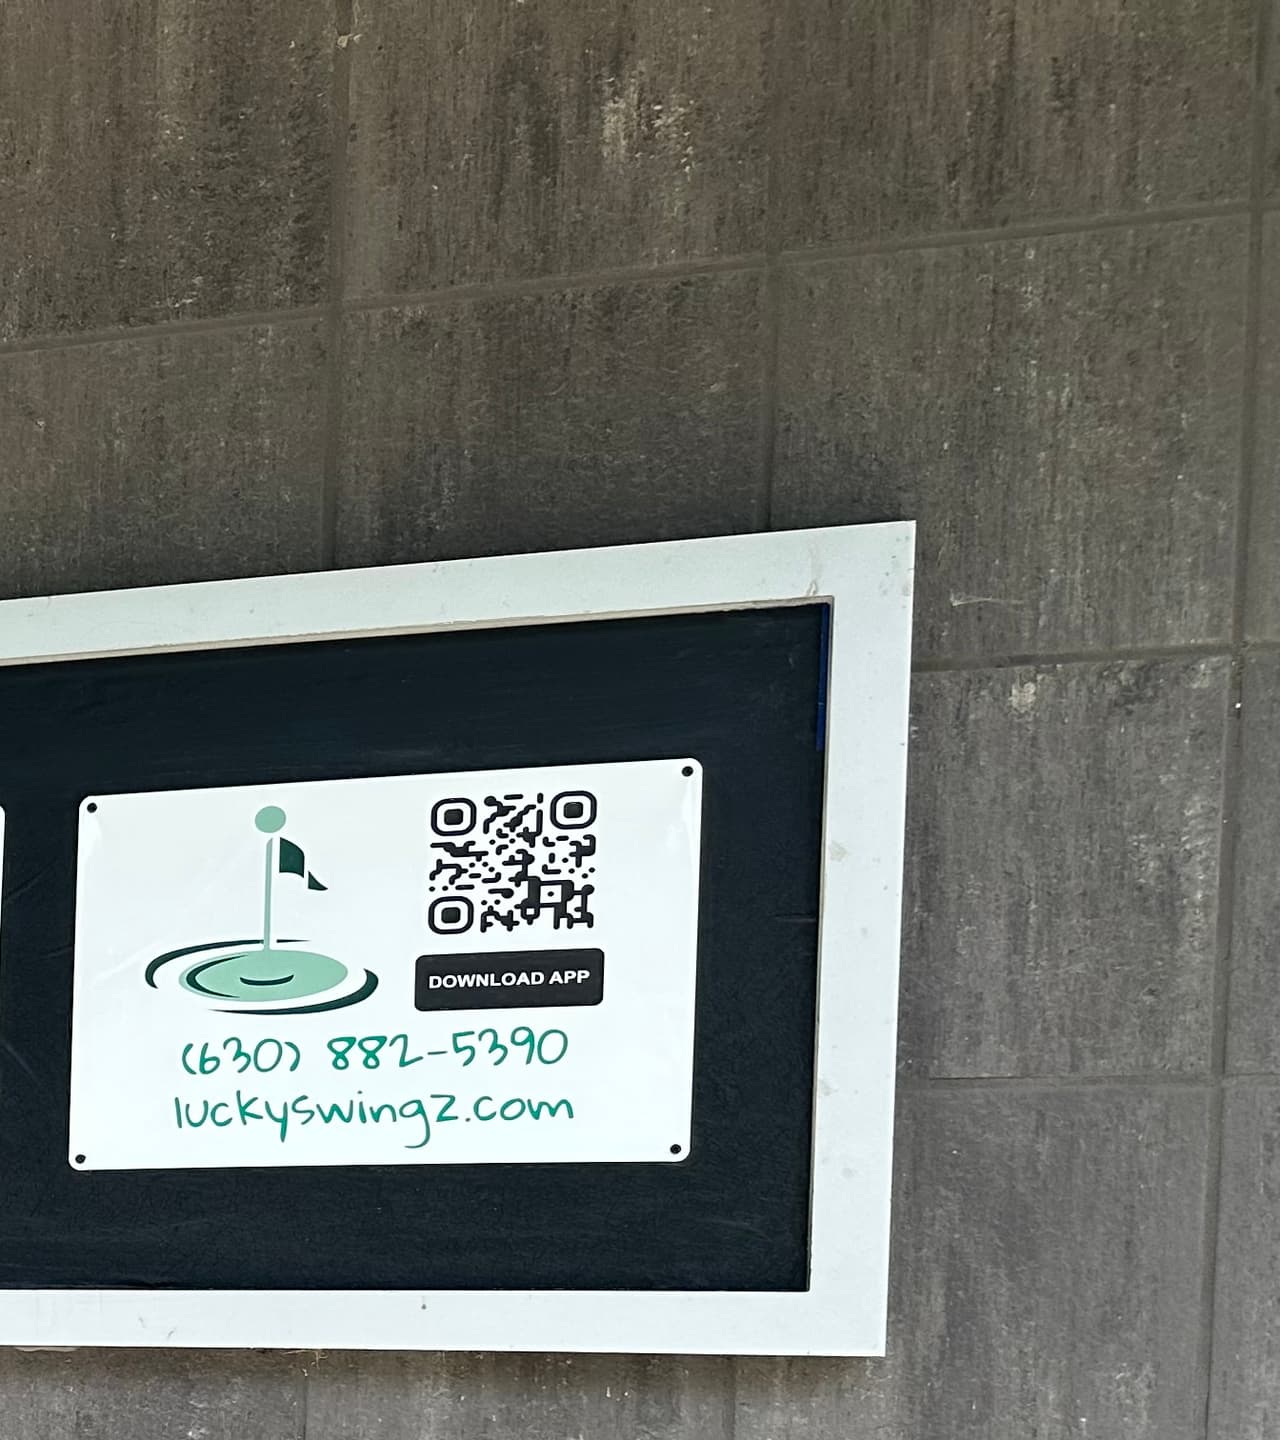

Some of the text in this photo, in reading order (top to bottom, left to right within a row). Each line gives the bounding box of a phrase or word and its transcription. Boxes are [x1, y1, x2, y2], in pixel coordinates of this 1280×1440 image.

[428, 969, 591, 990] DOWNLOAD APP
[182, 1025, 568, 1075] (630) 882-5390
[175, 1089, 575, 1150] luckyswingz.com
